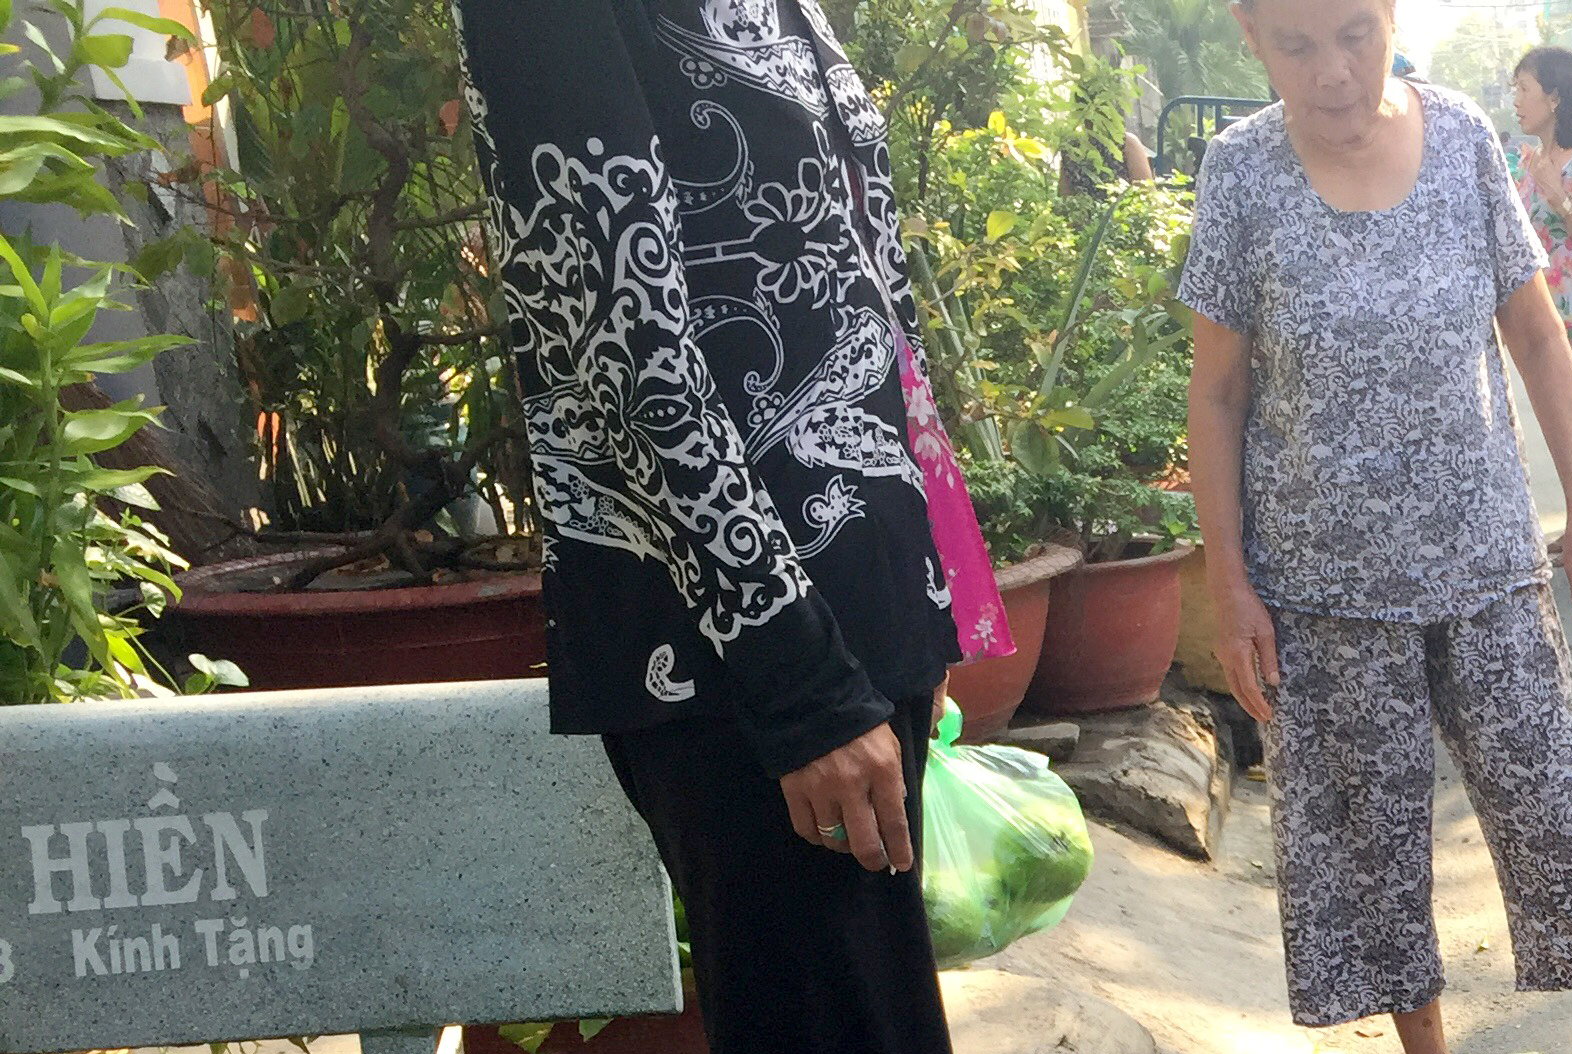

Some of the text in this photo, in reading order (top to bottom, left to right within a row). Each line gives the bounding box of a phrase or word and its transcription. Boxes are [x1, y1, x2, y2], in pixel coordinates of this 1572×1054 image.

[21, 762, 268, 915] HIỀN
[71, 923, 182, 978] Kính
[196, 917, 313, 979] Tặng
